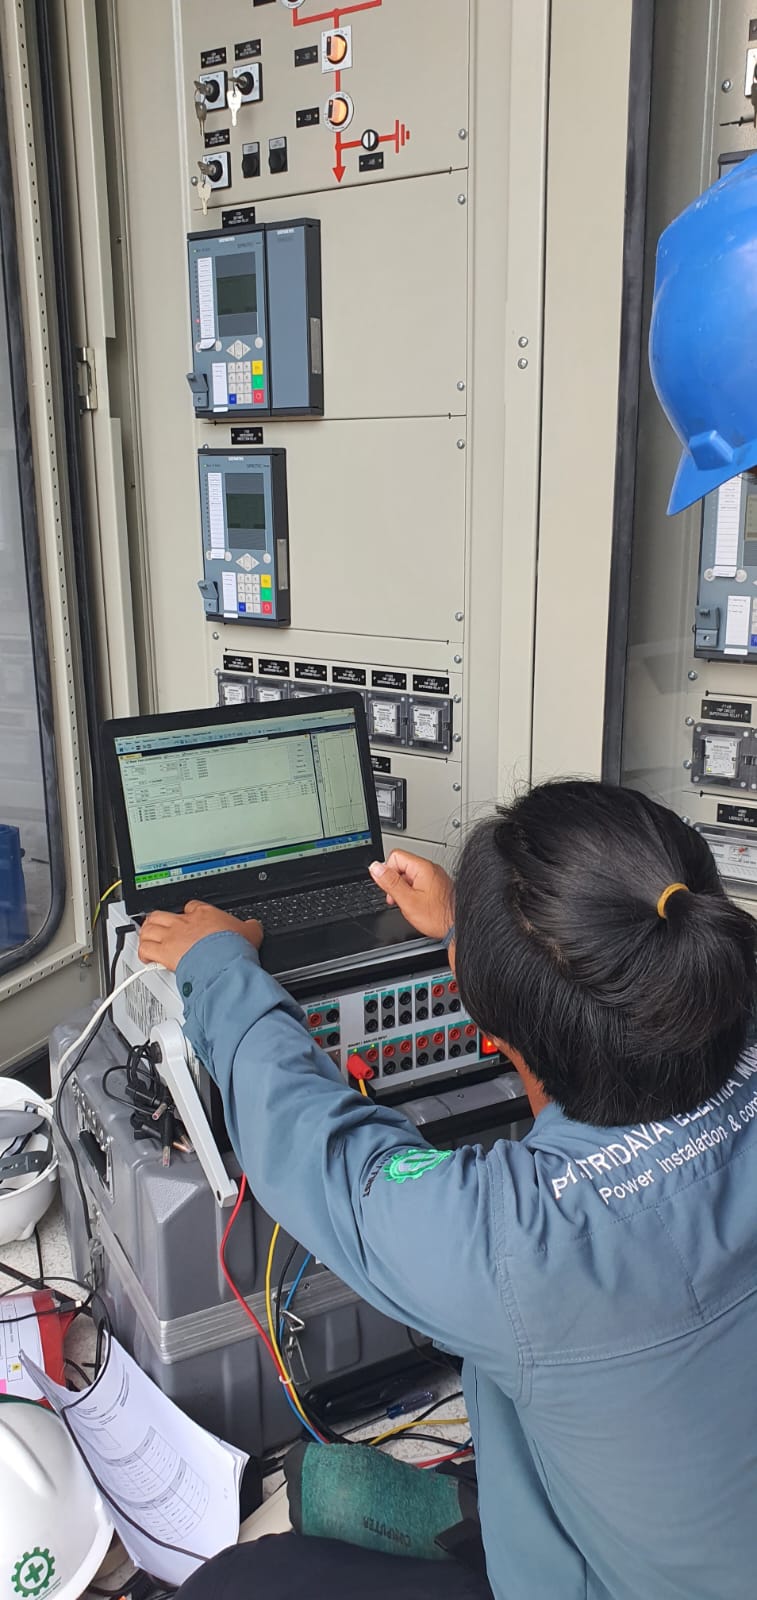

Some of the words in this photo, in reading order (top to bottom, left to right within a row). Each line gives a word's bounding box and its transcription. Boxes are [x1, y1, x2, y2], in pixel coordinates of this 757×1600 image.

[573, 1121, 674, 1180] TRIDAYA
[598, 1168, 656, 1206] Power
[727, 1114, 742, 1132] &
[363, 1515, 412, 1548] COMPUTER
